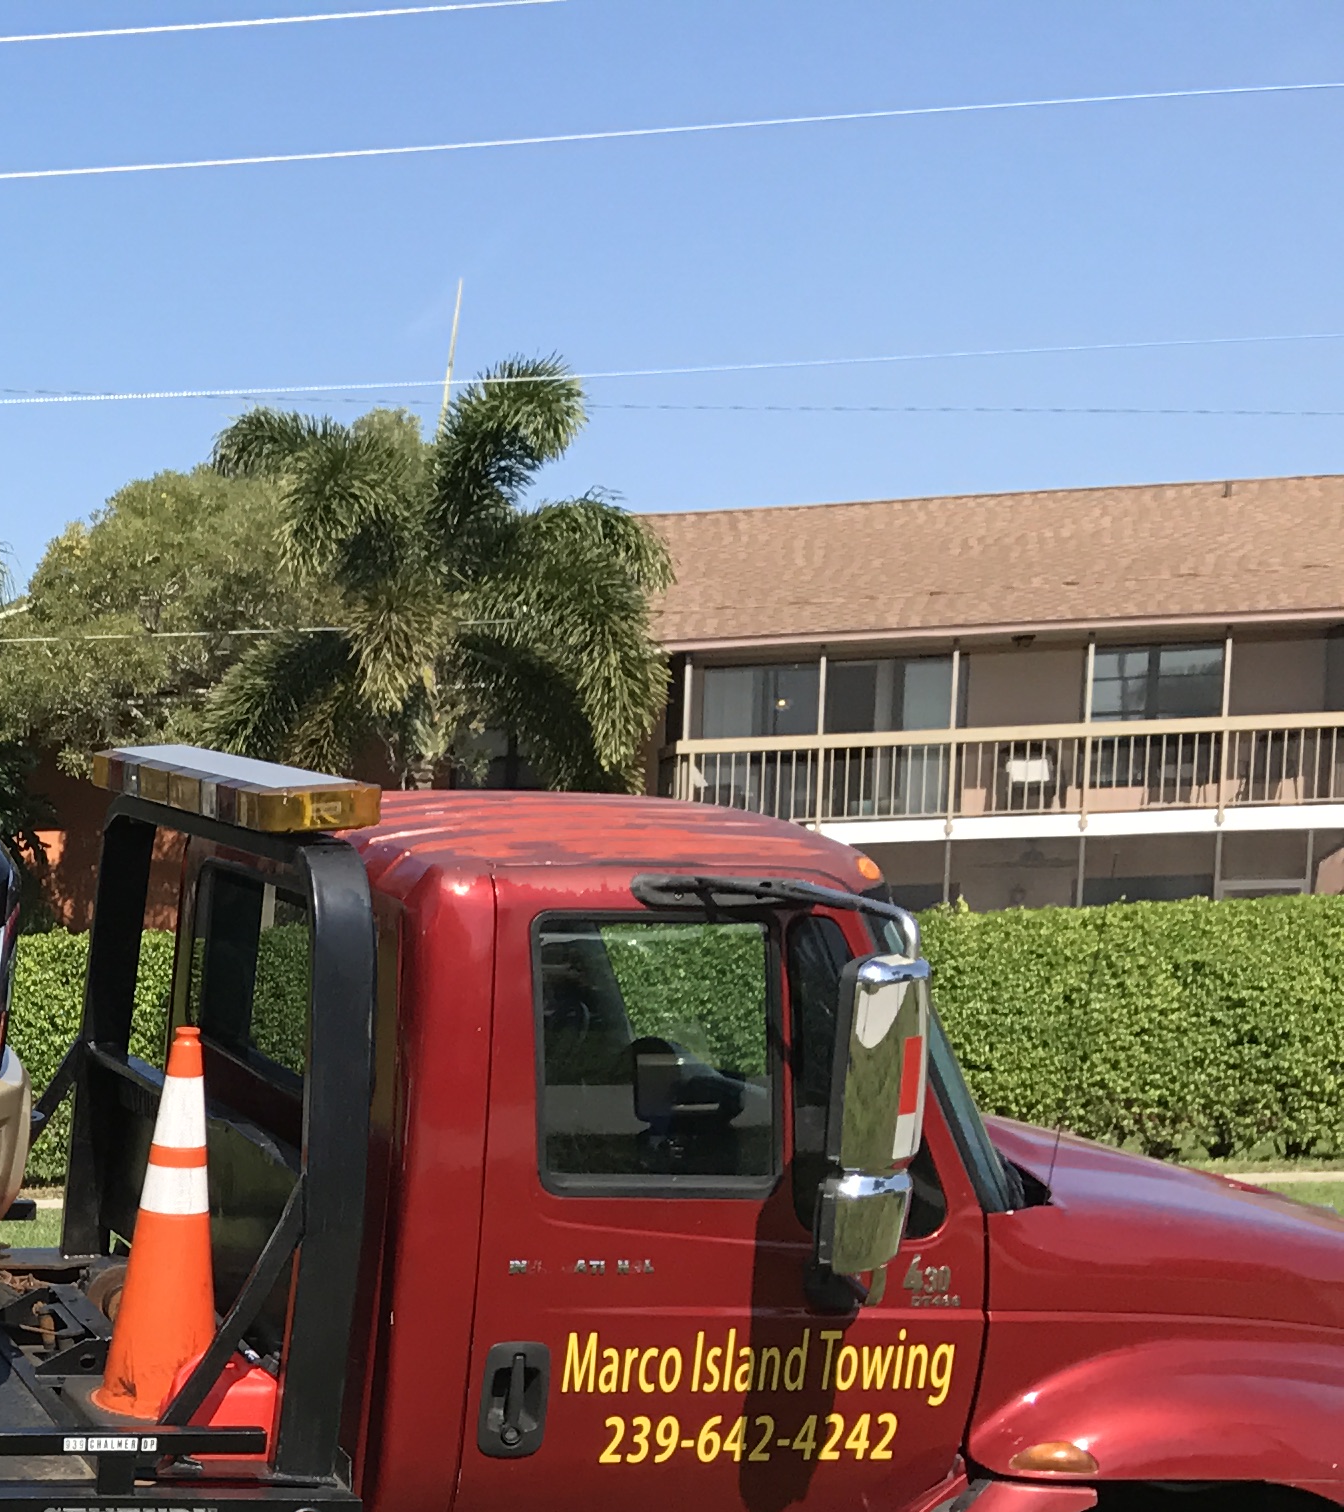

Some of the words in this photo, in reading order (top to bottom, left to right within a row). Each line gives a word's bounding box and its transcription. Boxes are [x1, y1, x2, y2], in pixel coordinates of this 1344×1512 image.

[561, 1332, 682, 1393] Marco
[691, 1328, 809, 1392] Island
[821, 1329, 955, 1406] Towing
[89, 1439, 136, 1450] CHALMER
[599, 1413, 897, 1464] 239-642-4242
